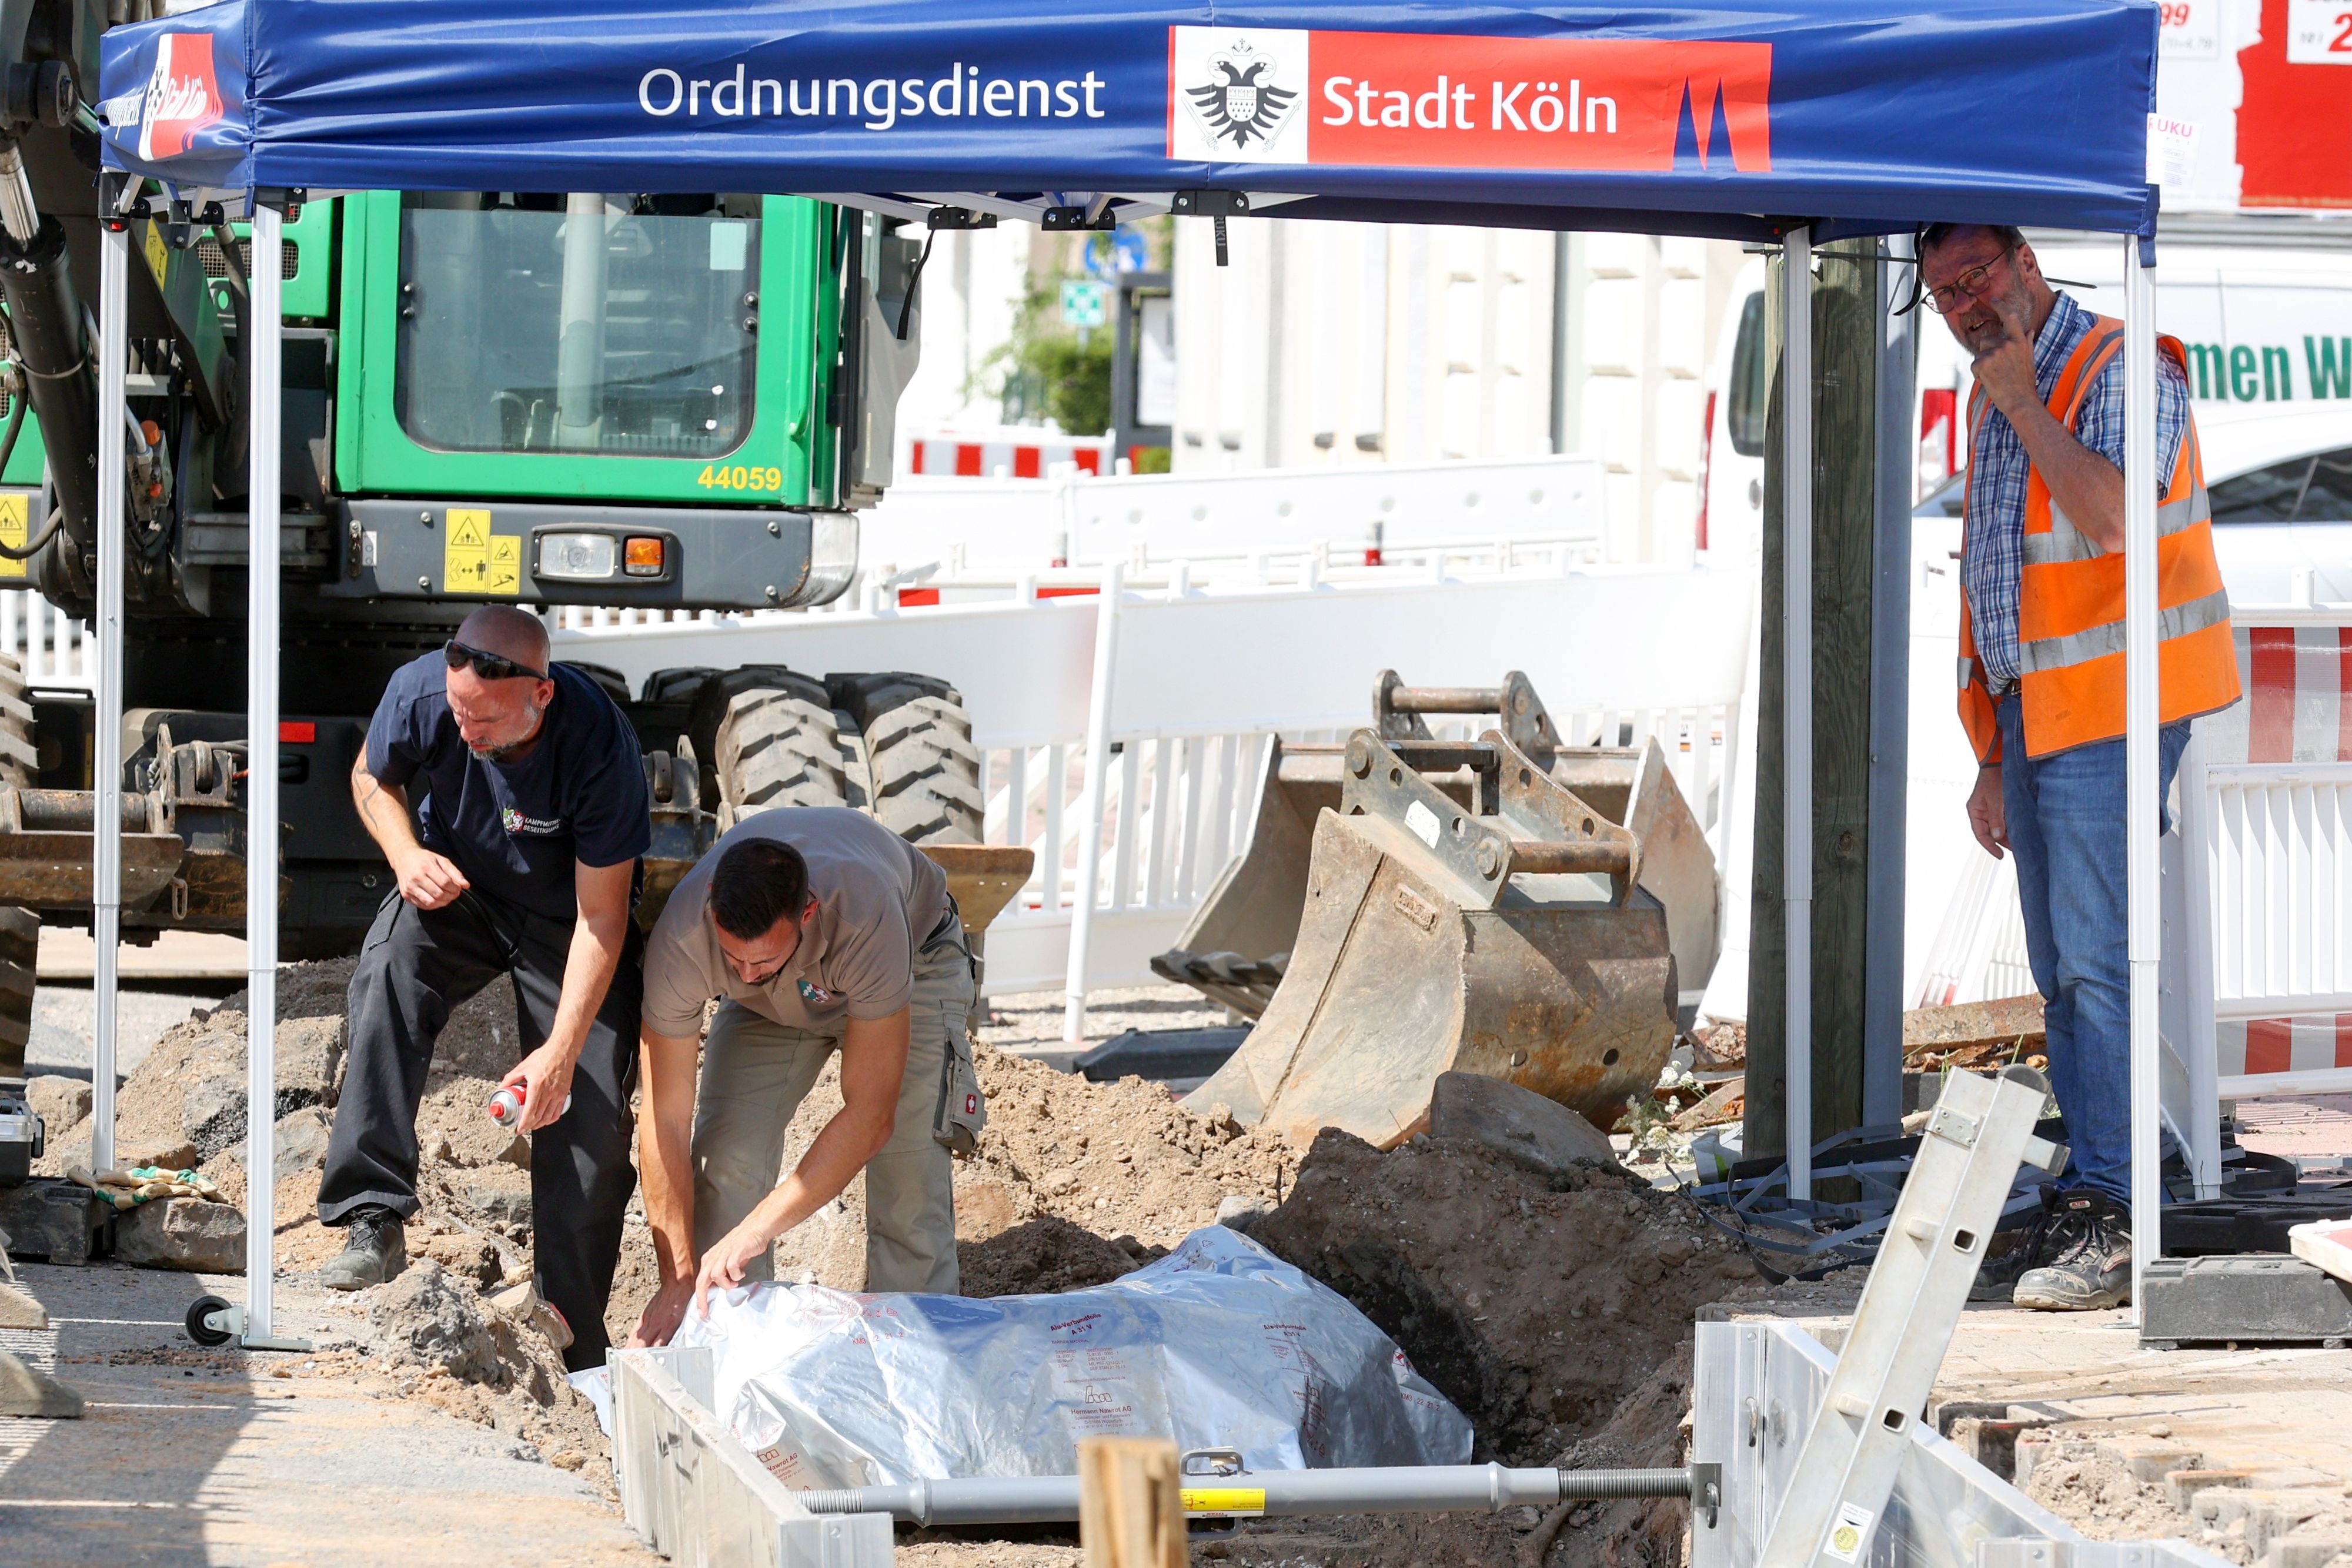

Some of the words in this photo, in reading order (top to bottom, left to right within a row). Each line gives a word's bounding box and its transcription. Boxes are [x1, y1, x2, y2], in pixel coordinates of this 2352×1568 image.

[638, 62, 1105, 131] Ordnungsdienst
[1323, 75, 1475, 129] Stadt
[1492, 79, 1617, 133] Köln
[698, 466, 781, 490] 44059
[523, 824, 559, 834] BESEITIGUNG
[1050, 1313, 1101, 1332] Alu-Verbundfolie
[1401, 1393, 1412, 1402] KM3
[1417, 1398, 1424, 1406] 22
[767, 1459, 789, 1471] Nawrot
[790, 1452, 798, 1461] AG
